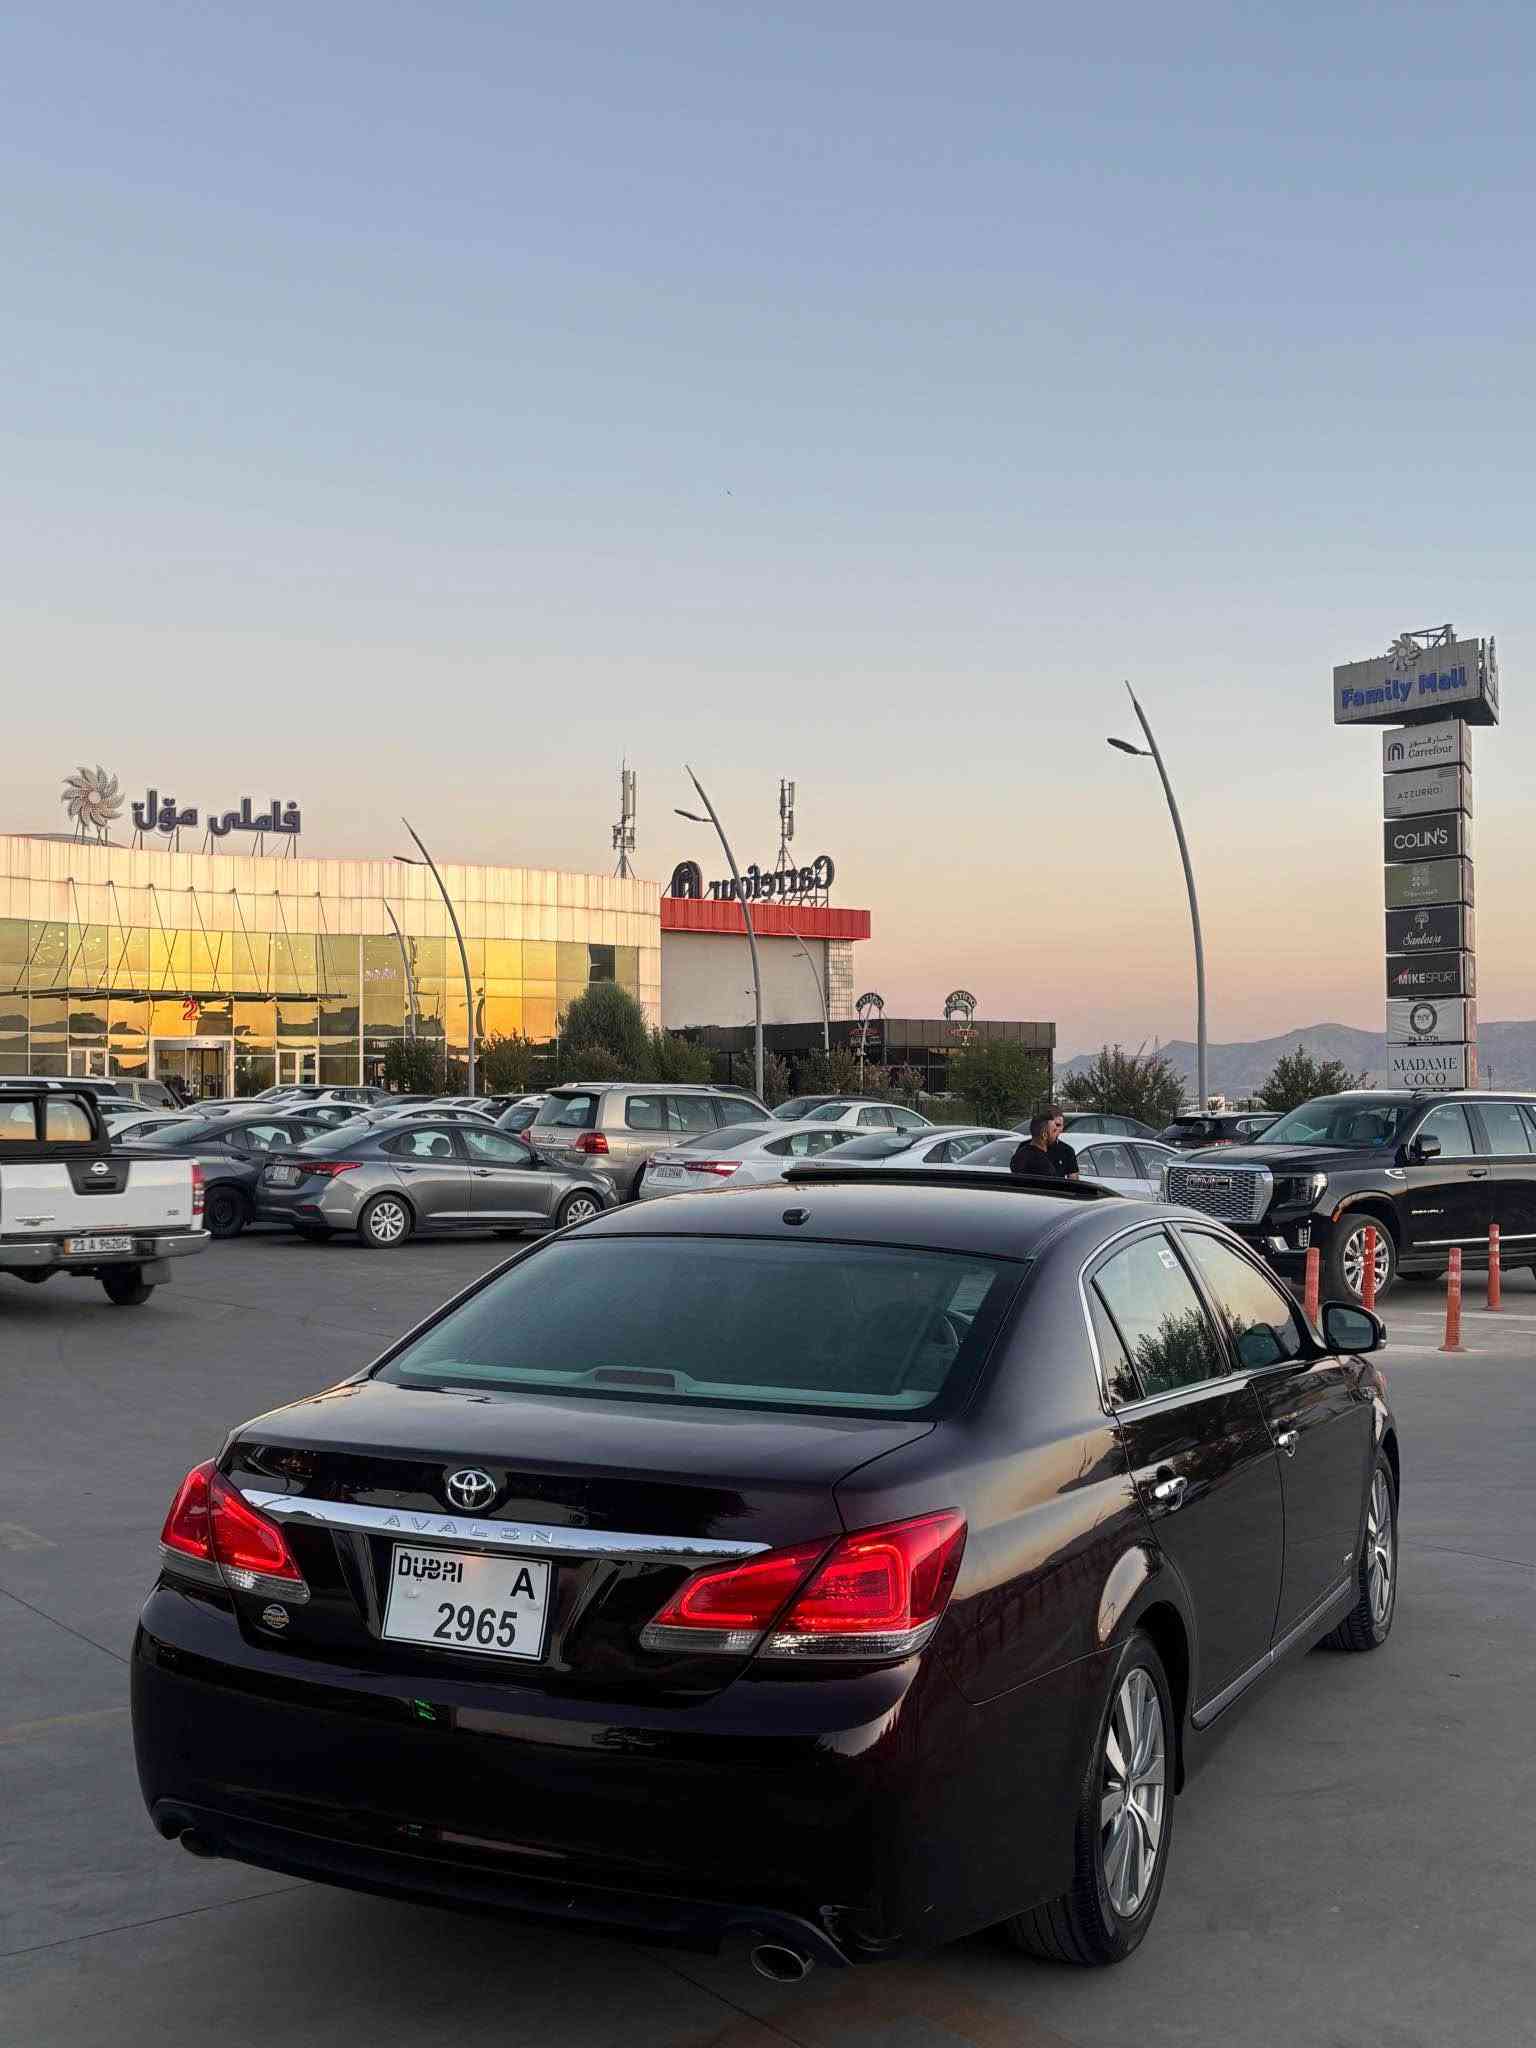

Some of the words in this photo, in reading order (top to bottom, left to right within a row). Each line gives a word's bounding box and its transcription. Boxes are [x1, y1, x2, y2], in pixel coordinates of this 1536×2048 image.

[1342, 679, 1412, 708] Family
[1418, 665, 1467, 694] Mall
[1408, 745, 1454, 759] Carrefour
[1397, 786, 1440, 799] AZZURRO
[1394, 828, 1448, 849] COLIN'S
[182, 999, 198, 1021] 2
[1393, 1056, 1457, 1072] MADAME
[1404, 1072, 1446, 1086] COCO
[384, 1514, 553, 1544] AVALON
[510, 1567, 535, 1600] A
[433, 1602, 517, 1648] 2965
